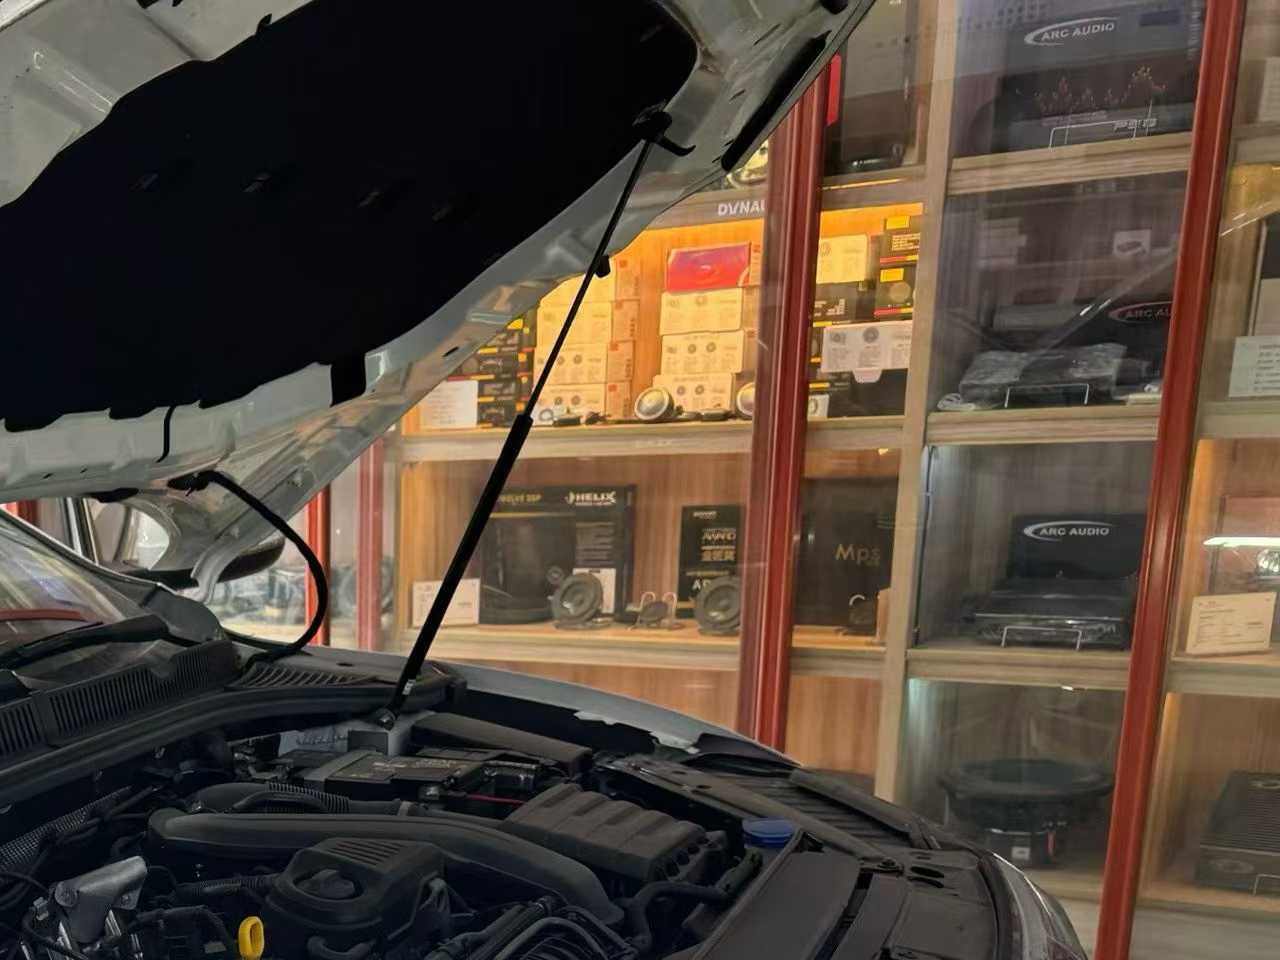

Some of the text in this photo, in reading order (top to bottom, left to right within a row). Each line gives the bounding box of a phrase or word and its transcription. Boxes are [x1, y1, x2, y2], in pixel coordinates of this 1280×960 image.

[1040, 21, 1115, 42] ARC AUDIO
[1039, 527, 1110, 537] ARC AUDIO
